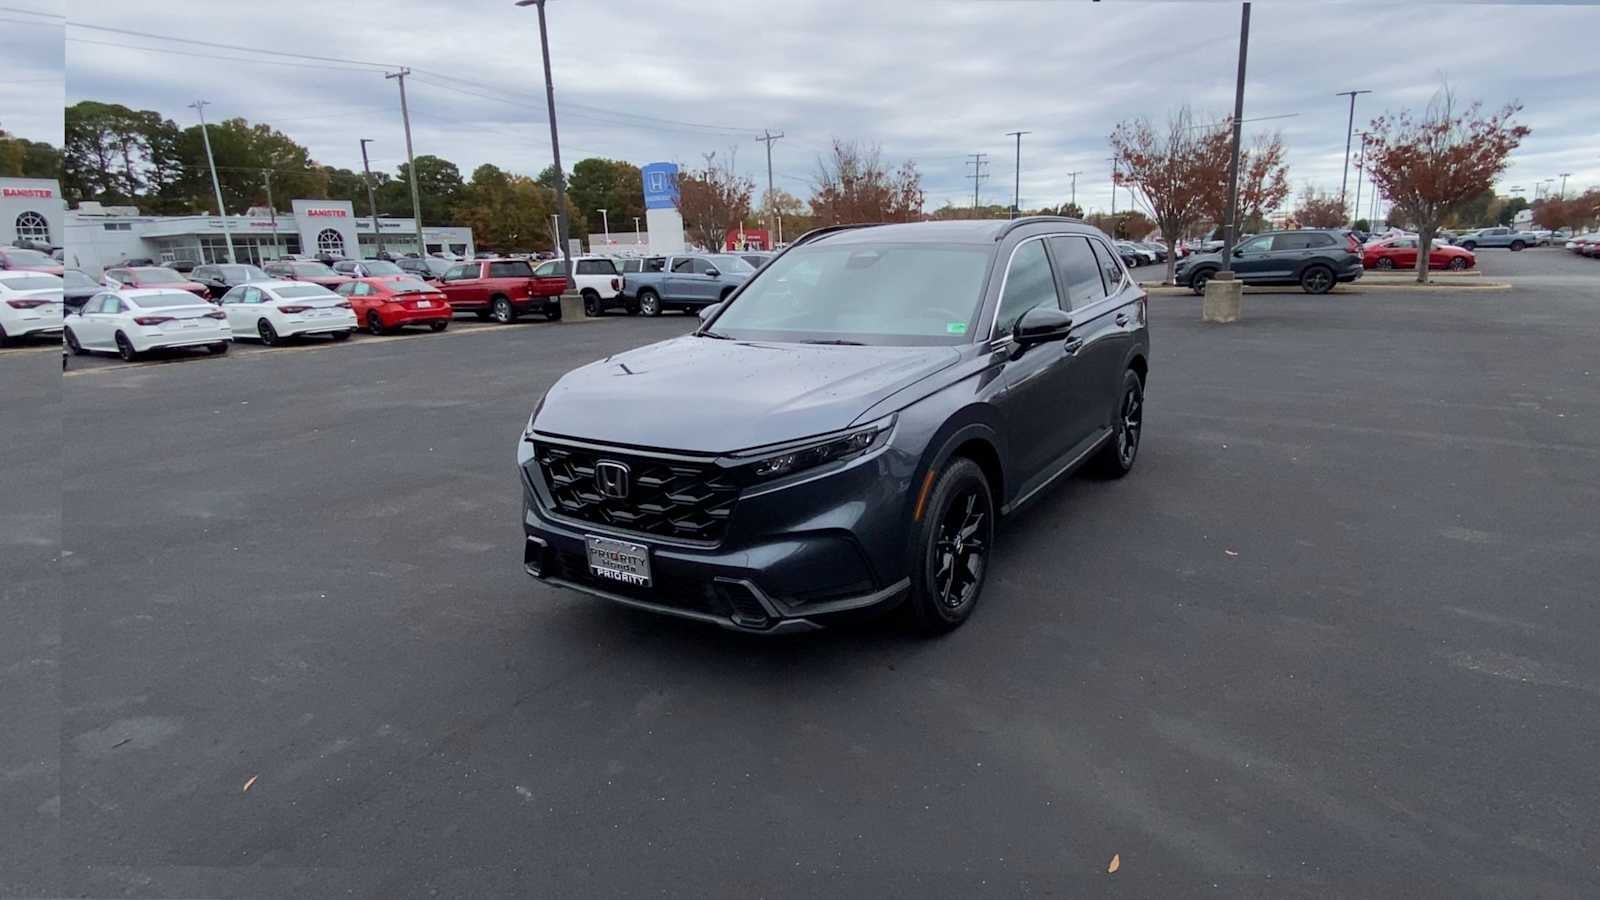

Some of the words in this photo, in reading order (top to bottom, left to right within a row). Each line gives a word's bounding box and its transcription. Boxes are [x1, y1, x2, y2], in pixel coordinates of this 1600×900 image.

[3, 188, 52, 198] BANISTER
[307, 209, 346, 217] BANISTER
[591, 549, 646, 566] PRIORITY
[597, 568, 644, 585] PRIORITY
